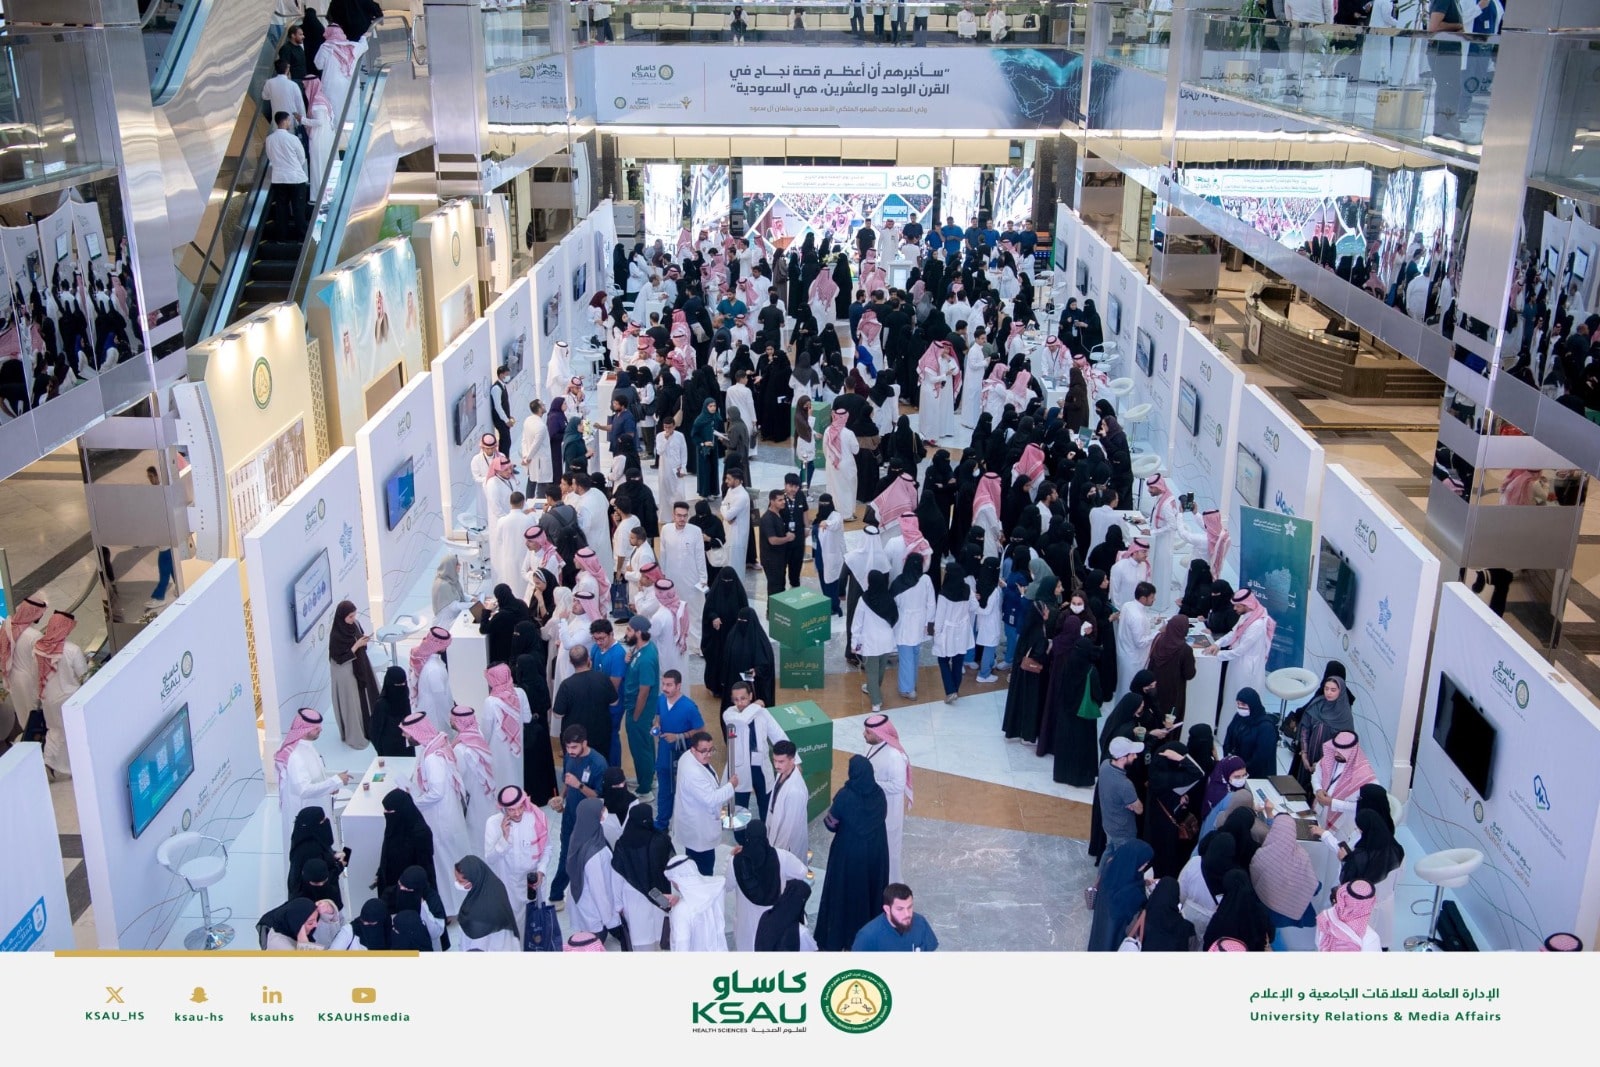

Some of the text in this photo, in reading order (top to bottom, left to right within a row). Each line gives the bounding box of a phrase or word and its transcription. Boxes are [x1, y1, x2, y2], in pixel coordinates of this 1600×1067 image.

[730, 65, 751, 81] في
[754, 65, 790, 79] نجاح
[793, 65, 820, 76] قصة
[824, 62, 865, 80] أعظم
[867, 62, 880, 80] أن
[794, 86, 817, 98] هي
[881, 84, 916, 97] الواحد
[918, 84, 950, 97] القرن
[160, 674, 180, 700] KSAU
[1493, 666, 1514, 694] KSAU
